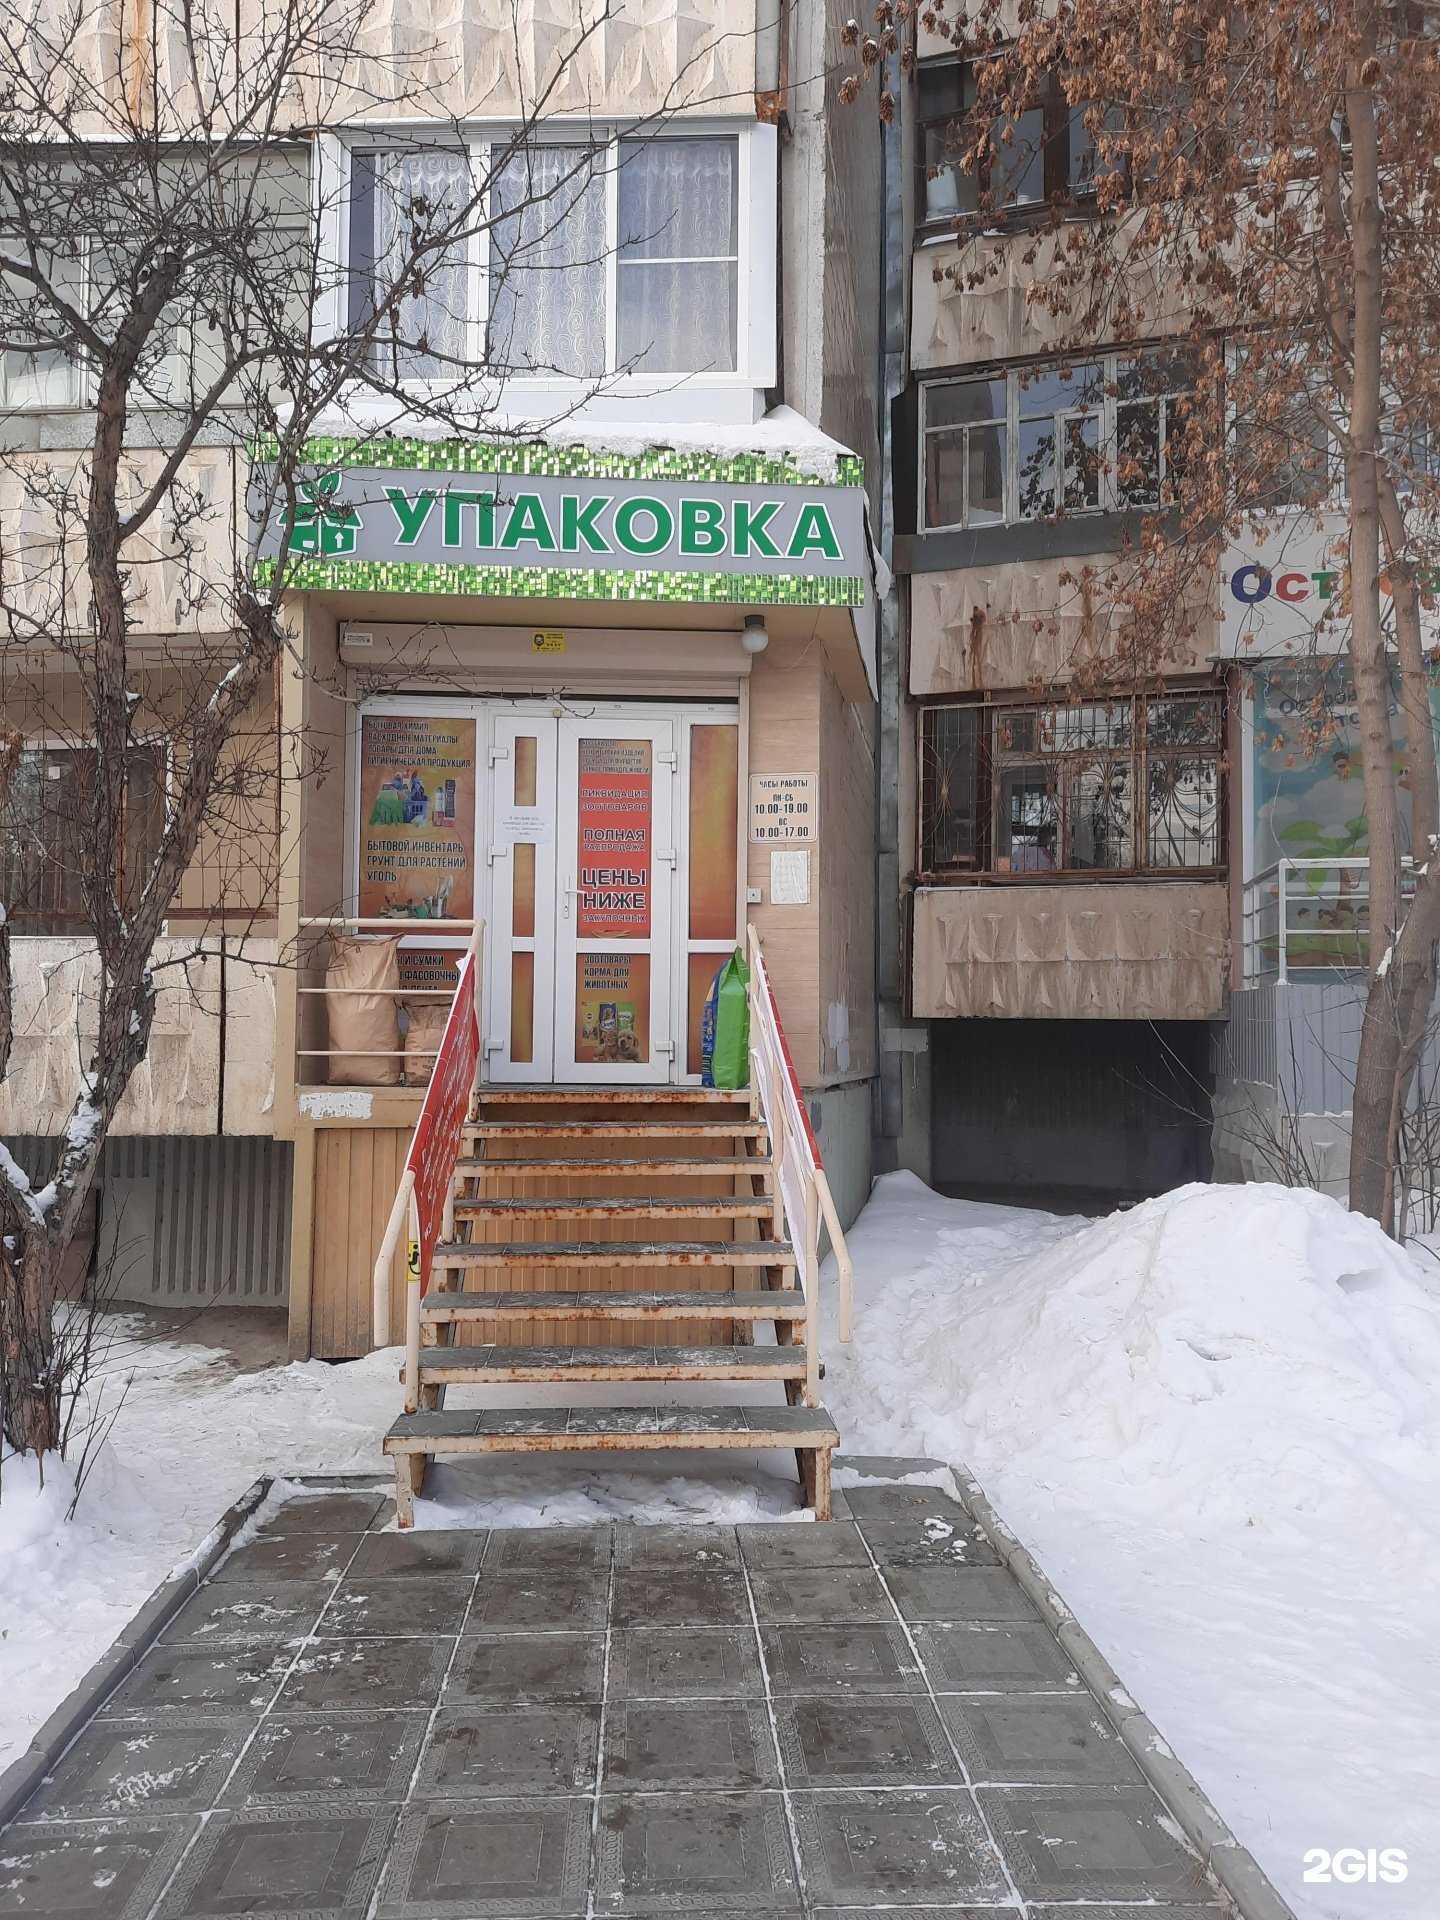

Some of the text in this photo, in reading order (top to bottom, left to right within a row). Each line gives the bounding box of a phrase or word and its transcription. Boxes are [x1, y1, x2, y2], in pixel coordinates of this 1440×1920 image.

[382, 484, 844, 561] УПАКОВКА
[414, 733, 459, 744] МАТЕРИАЛЫ
[416, 746, 437, 755] ДОМА
[427, 758, 471, 768] ПРОДУКЦИЯ
[760, 779, 808, 788] ЧАСЫ РАБОТЫ
[772, 793, 793, 802] ПН-СБ
[584, 829, 645, 841] ПОЛНАЯ
[367, 840, 464, 853] БЫТОВОЙ ИНВЕНТАРЬ
[367, 855, 396, 867] ГРУНТ
[398, 857, 418, 868] ДЛЯ
[367, 870, 397, 882] УГОЛЬ
[582, 868, 647, 889] ЦЕНЫ
[583, 892, 645, 909] НИЖЕ
[413, 955, 444, 966] СУМКИ
[404, 970, 462, 981] ФАСОВОЧНЫ
[584, 967, 629, 977] КОРМА ДЛЯ
[584, 979, 628, 989] ЖИВОТНЫХ
